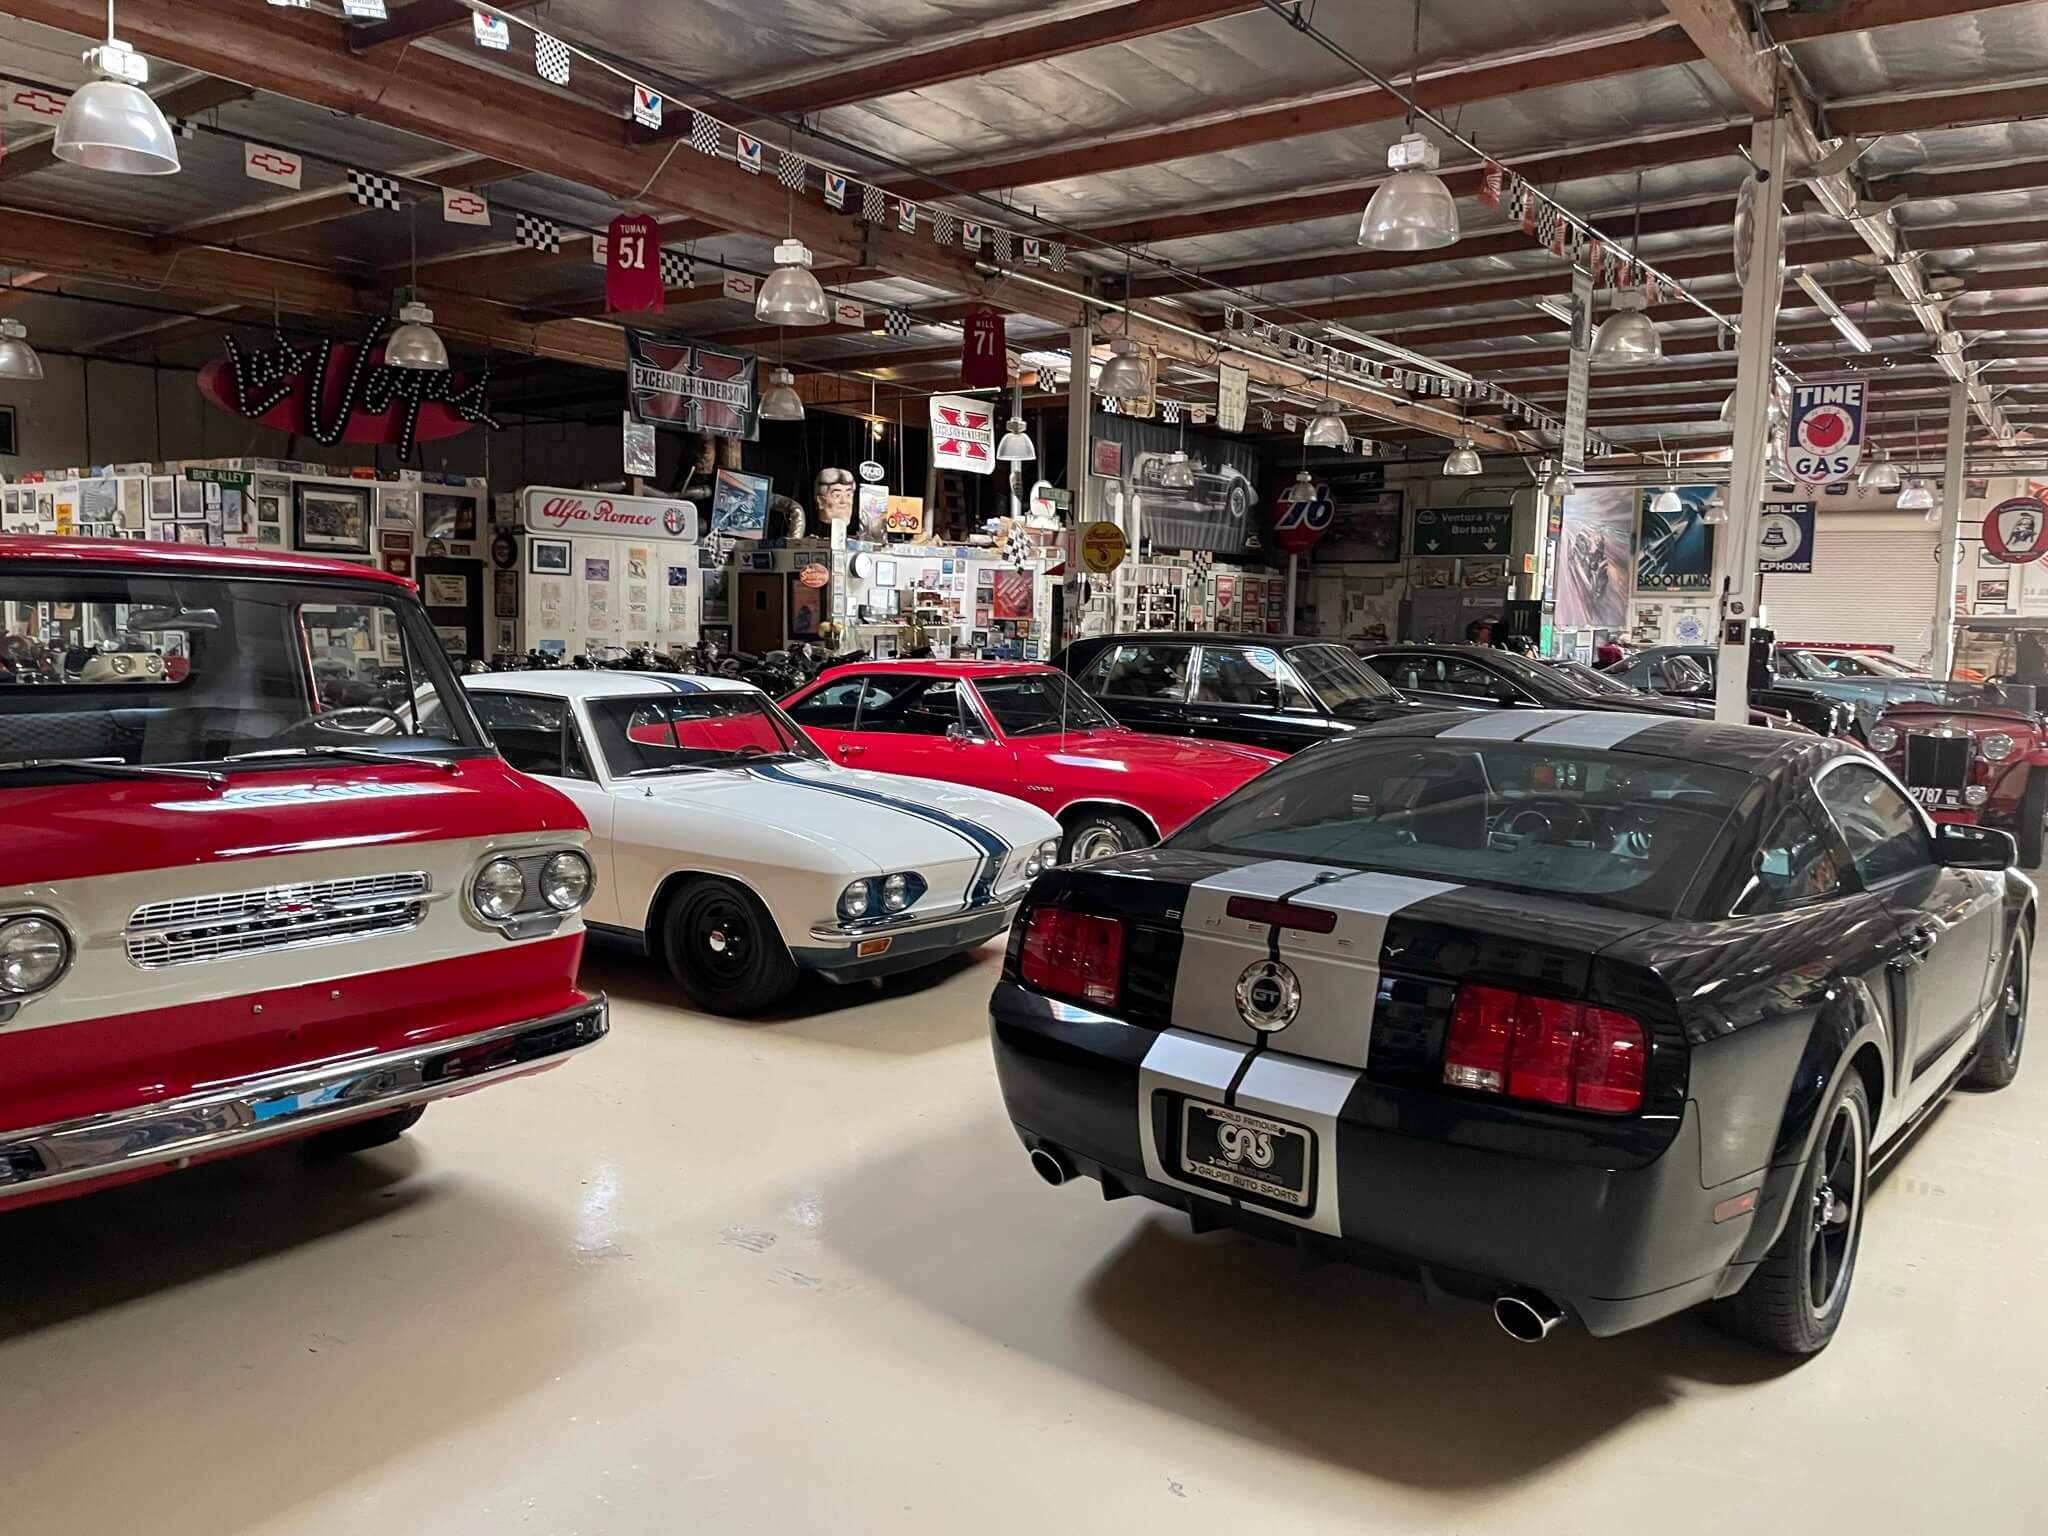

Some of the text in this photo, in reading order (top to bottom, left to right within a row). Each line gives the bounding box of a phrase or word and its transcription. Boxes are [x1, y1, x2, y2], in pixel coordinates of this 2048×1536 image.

[620, 224, 647, 235] TUMAN
[618, 237, 645, 269] 51
[975, 319, 995, 329] HILL
[973, 331, 994, 356] 71
[634, 368, 747, 404] EXCELSIOR-HENDERSON
[1796, 384, 1862, 407] TIME
[1796, 456, 1849, 475] GAS
[192, 469, 245, 483] BIKE ALLEY
[543, 497, 656, 528] Alfa Romeo
[1760, 504, 1808, 513] UBLIC
[1441, 512, 1483, 523] Ventura
[1486, 512, 1511, 525] Fwy
[1452, 524, 1497, 535] Burbank
[1759, 562, 1810, 571] EPHONE
[1638, 574, 1711, 587] BROOKLANDS
[1254, 988, 1279, 1003] GT
[1213, 1109, 1279, 1133] WORLD FAMOUS
[1198, 1166, 1299, 1202] GALPIN AUTO SPORTS
